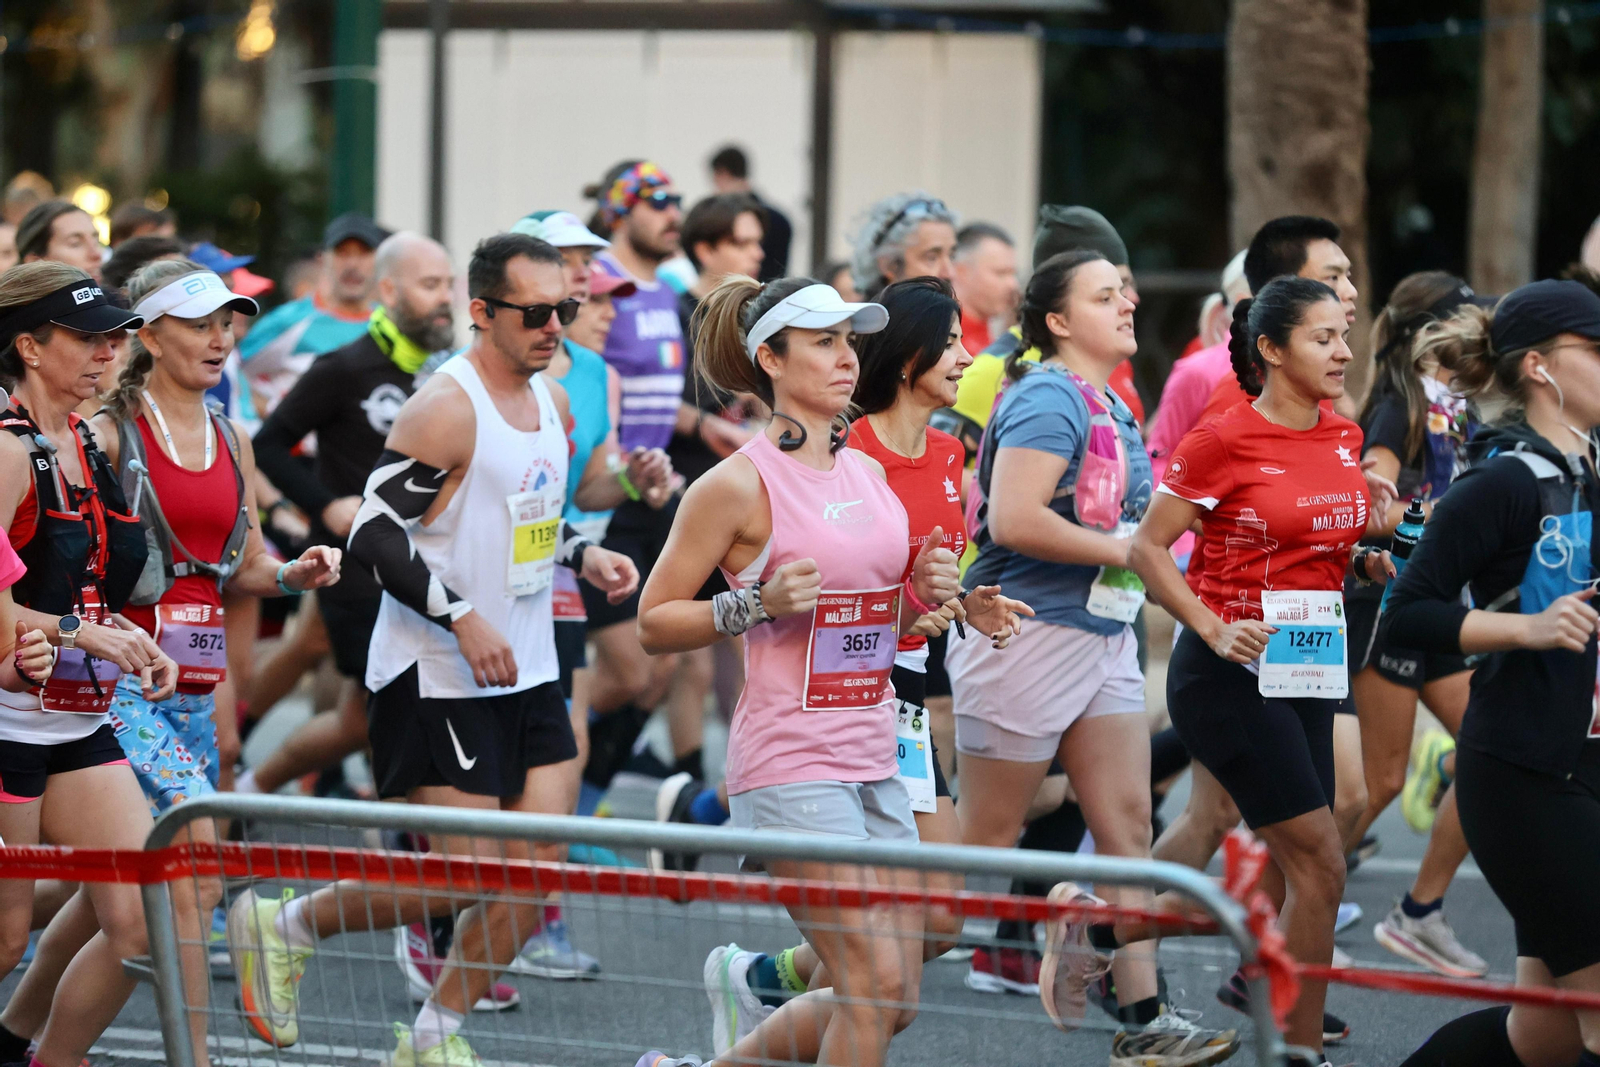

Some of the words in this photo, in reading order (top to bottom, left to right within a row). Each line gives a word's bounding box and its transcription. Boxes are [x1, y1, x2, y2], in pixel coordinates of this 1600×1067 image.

[76, 290, 91, 302] GB
[1309, 492, 1352, 505] GENERALI
[1312, 513, 1354, 531] MÁLAGA
[870, 602, 888, 611] 42K
[825, 610, 853, 624] MÁLAGA
[1276, 610, 1302, 621] MÁLAGA
[188, 632, 224, 650] 3672
[842, 632, 880, 652] 3657
[1289, 631, 1332, 648] 12477
